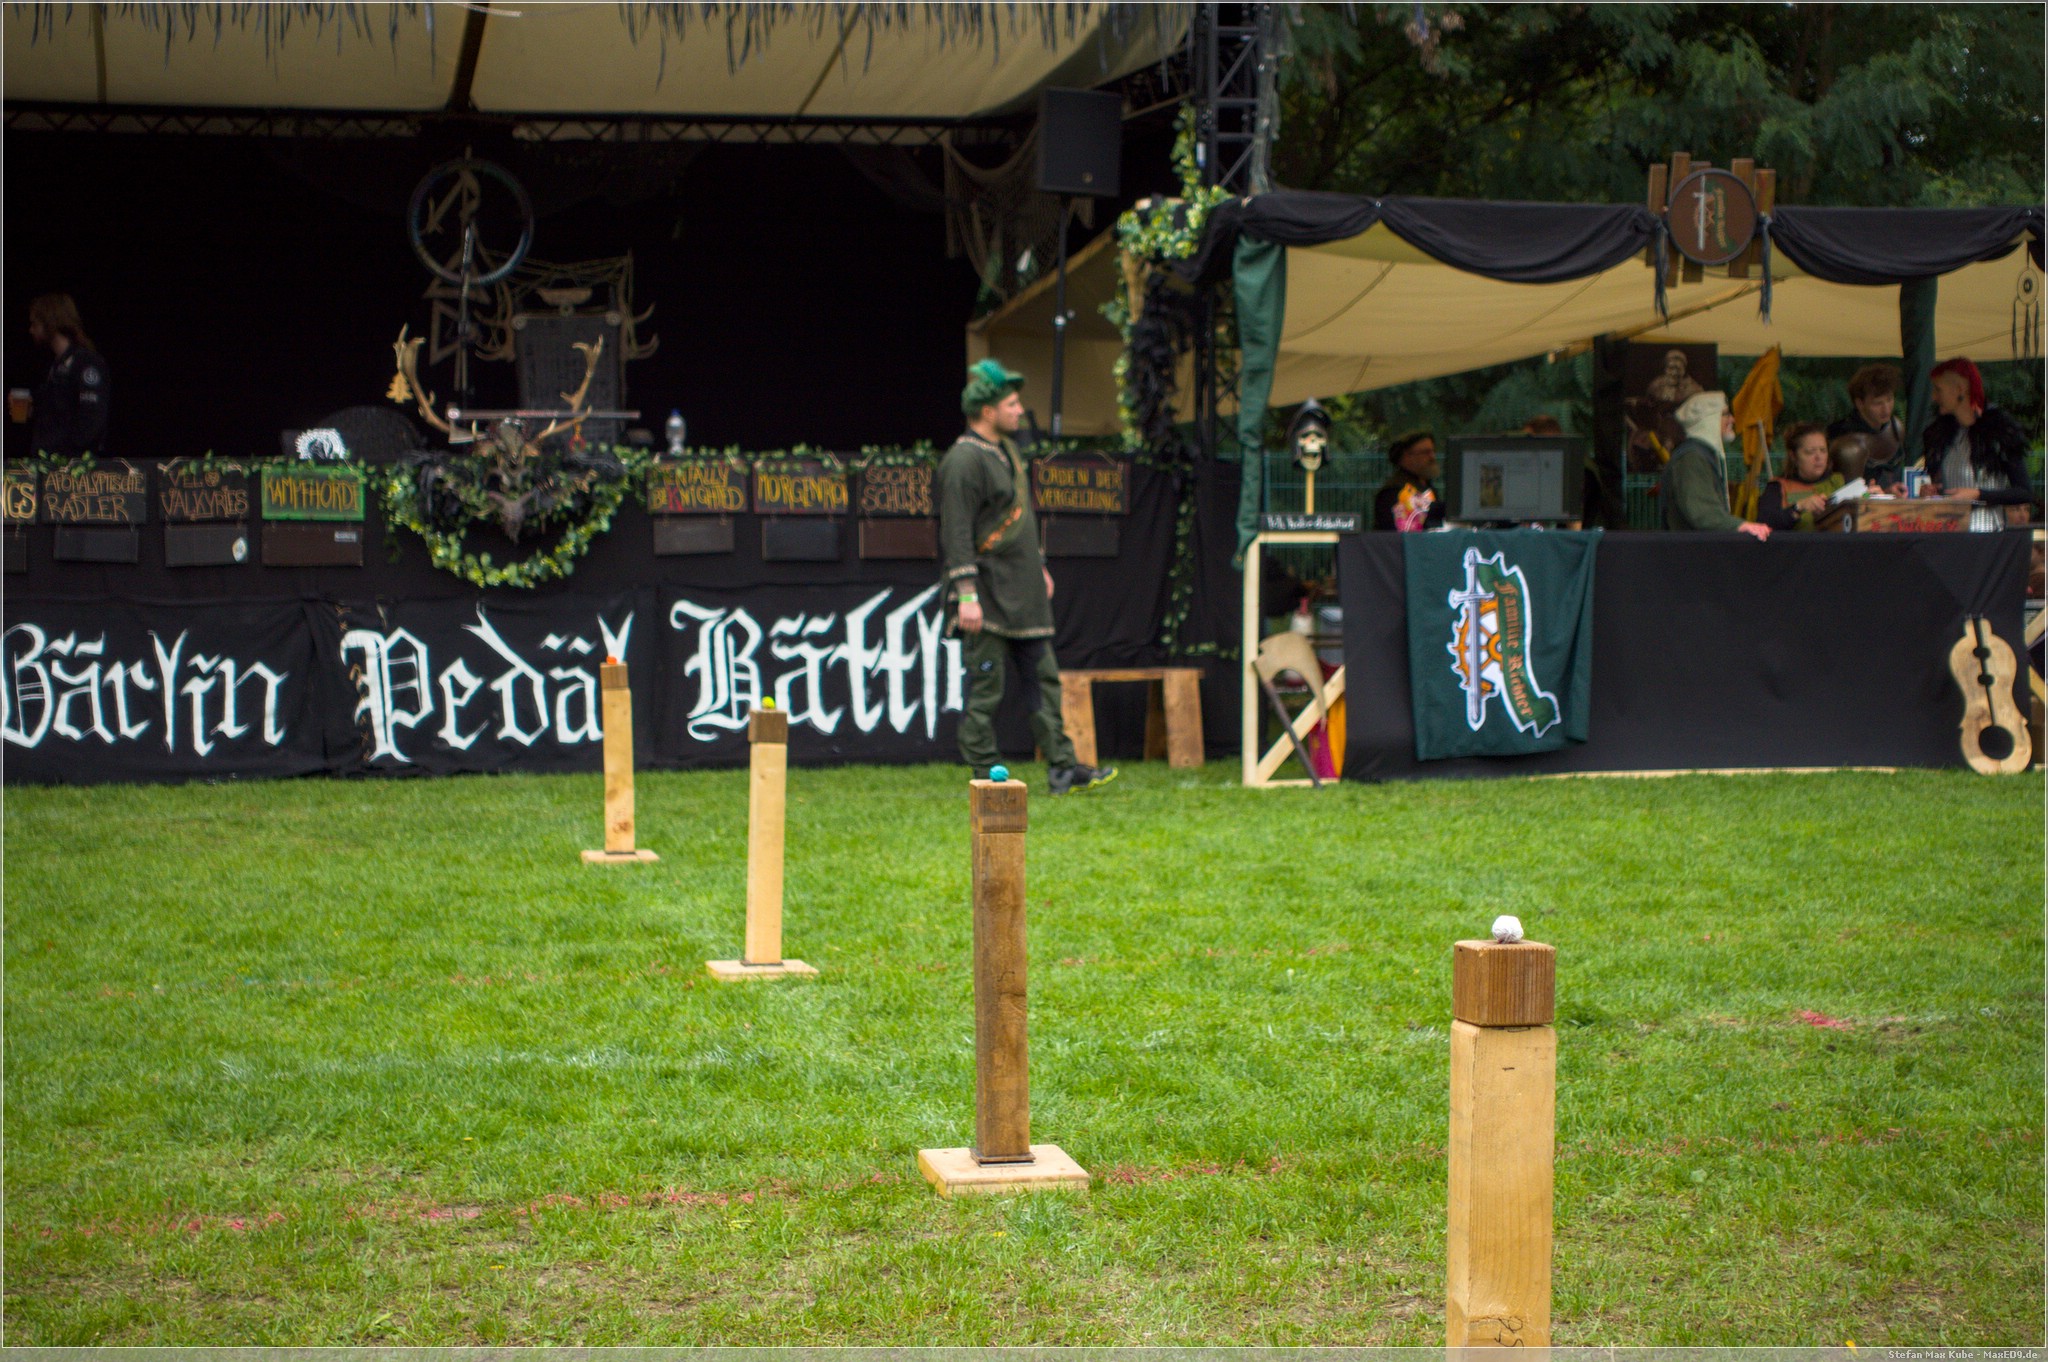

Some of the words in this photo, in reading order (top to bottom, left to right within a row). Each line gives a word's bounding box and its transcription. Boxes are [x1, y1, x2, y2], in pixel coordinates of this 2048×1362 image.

[45, 471, 145, 495] APOKALYPTISCHE
[865, 465, 932, 485] SOCKEN
[1038, 467, 1089, 486] ORDEN
[1095, 469, 1123, 489] DER
[4, 477, 36, 519] GS
[160, 487, 249, 518] VALKYRIES
[265, 476, 361, 512] KAMPFHORDE
[861, 484, 933, 514] SCHUSS
[1035, 487, 1121, 511] VERGELTUNG
[1493, 580, 1521, 648] Familie
[1507, 653, 1534, 716] Richter
[4, 622, 289, 757] Bärlin
